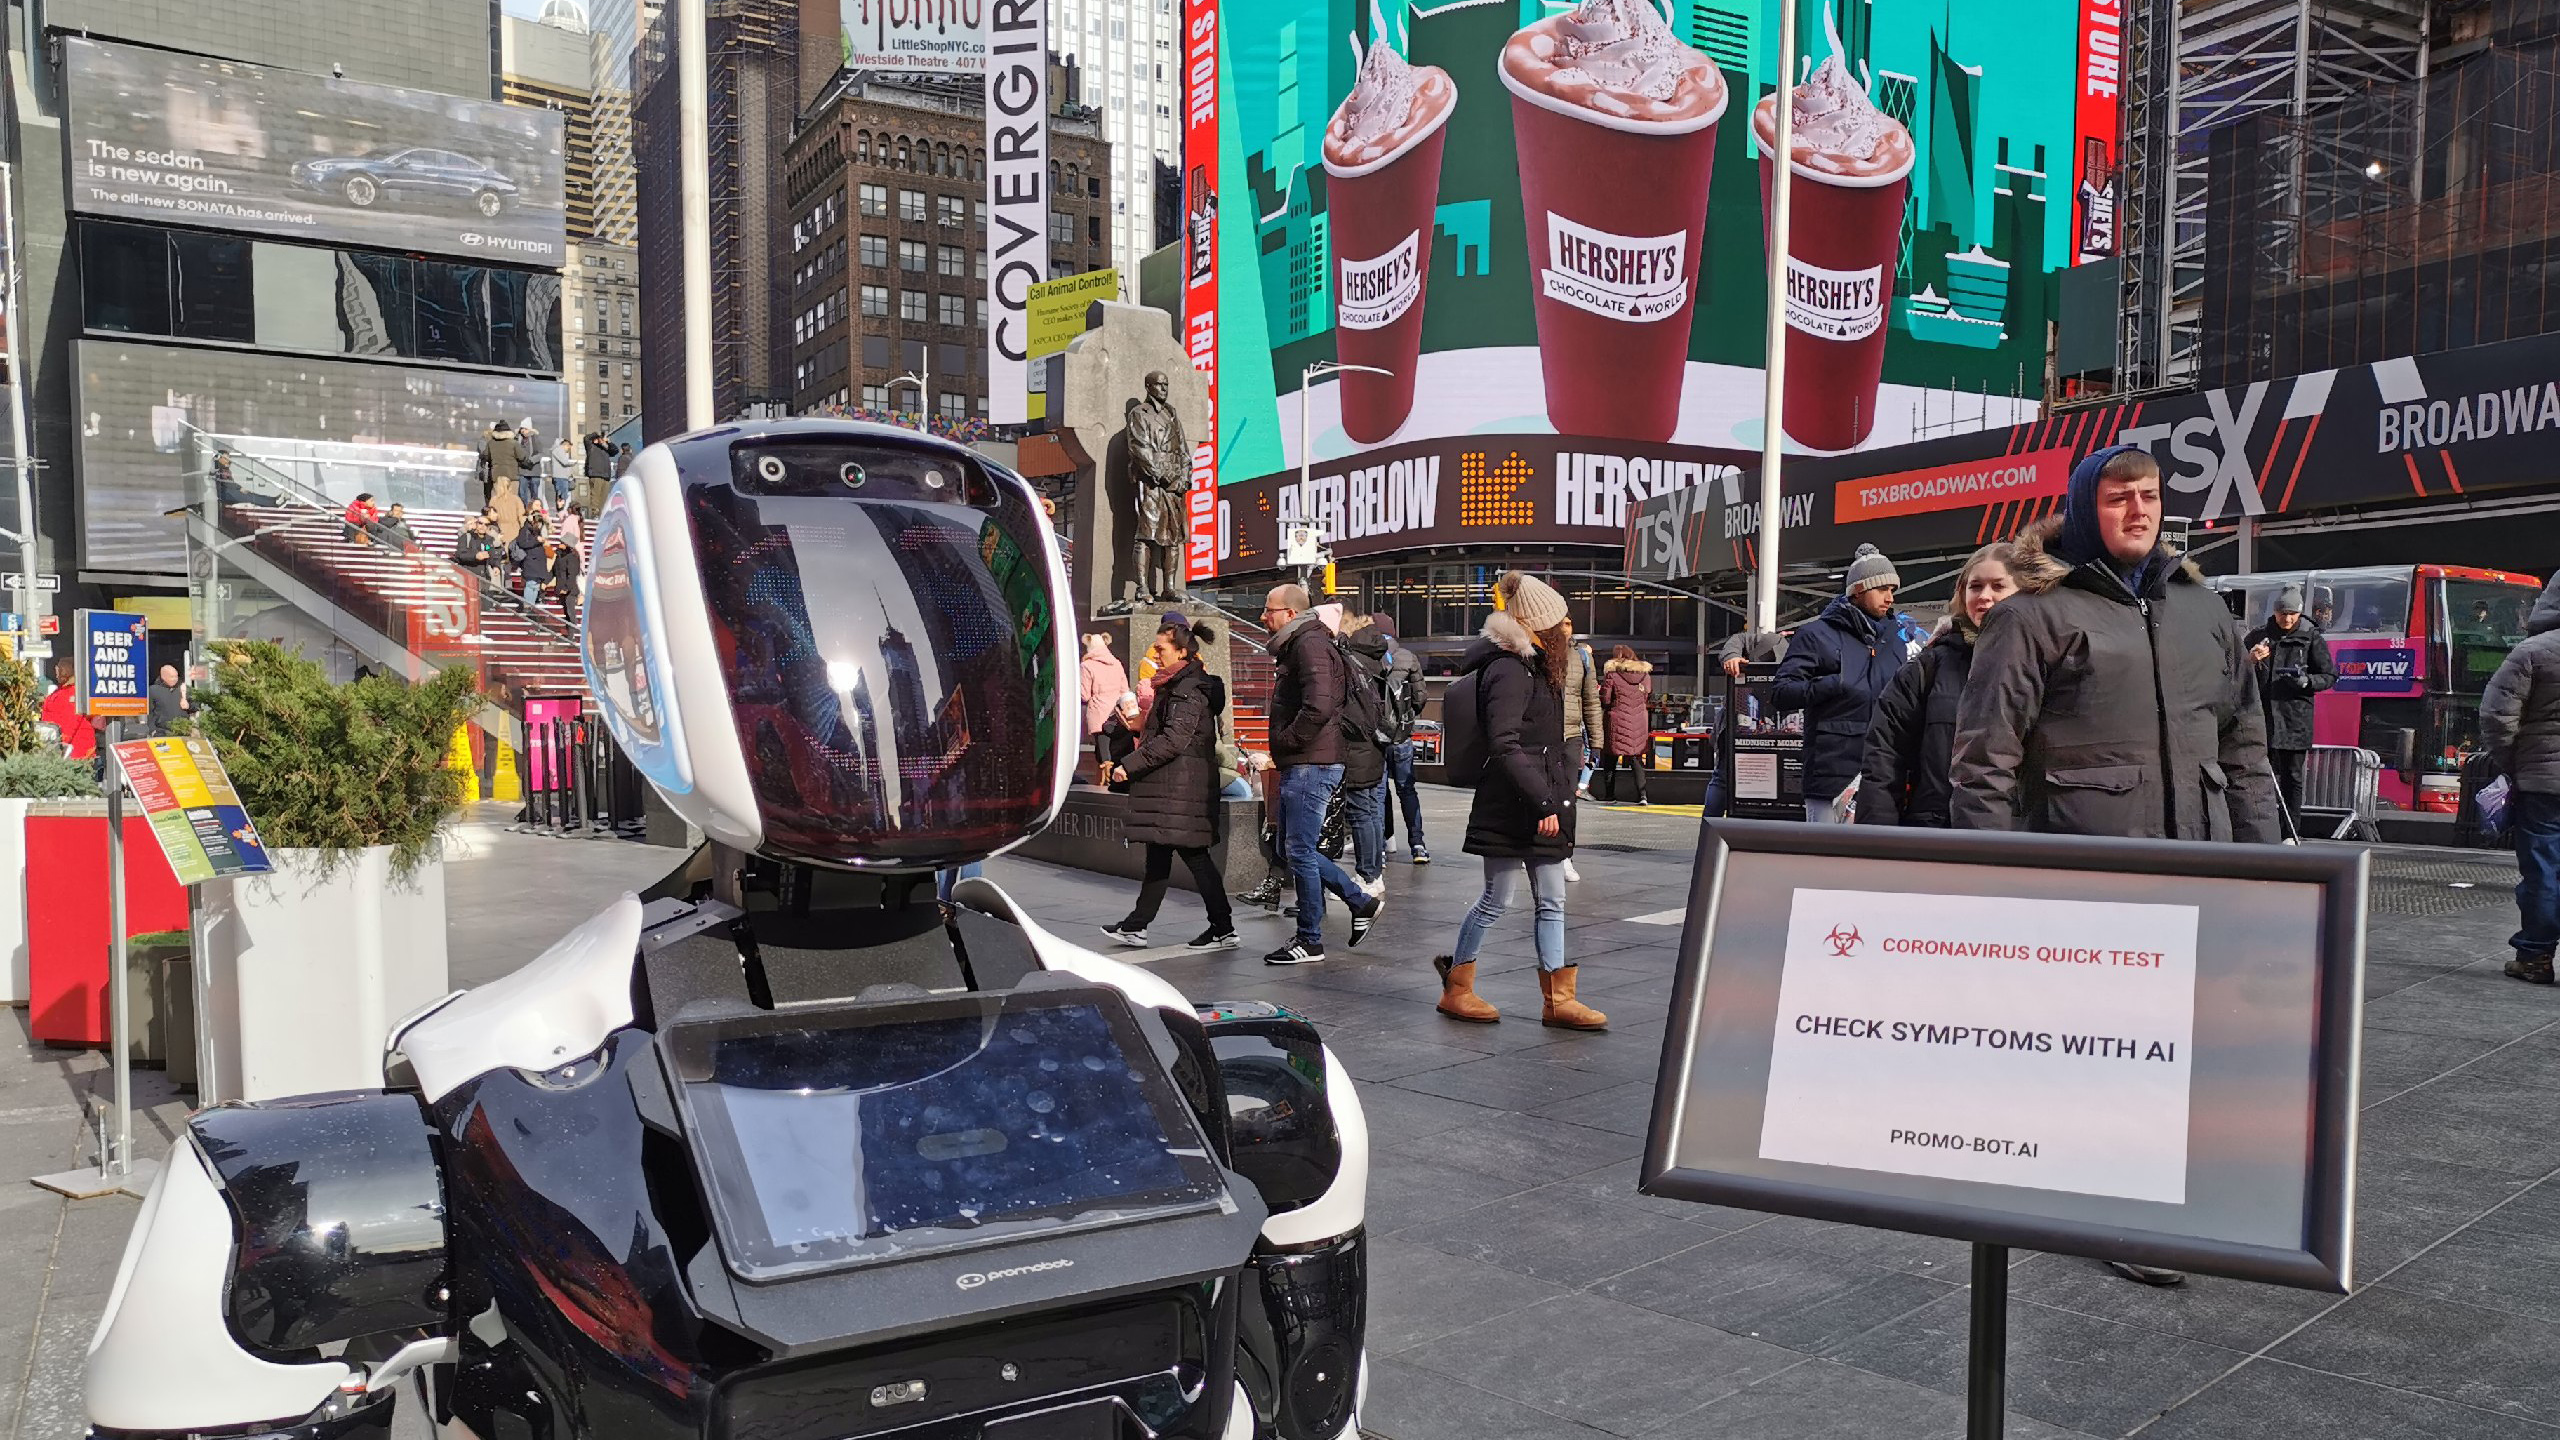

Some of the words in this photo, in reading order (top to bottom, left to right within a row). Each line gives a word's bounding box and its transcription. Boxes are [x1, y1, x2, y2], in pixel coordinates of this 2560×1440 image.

[854, 53, 904, 66] Westside
[907, 54, 948, 68] Theatre
[955, 56, 976, 68] 407
[1191, 9, 1216, 130] STORE
[86, 139, 130, 161] The
[135, 149, 205, 171] sedan
[88, 159, 106, 178] is
[112, 165, 160, 185] new
[165, 171, 235, 194] again.
[993, 0, 1040, 362] COVERGIR
[91, 188, 119, 202] The
[120, 194, 175, 210] all-new
[178, 199, 236, 216] SONATA
[237, 206, 263, 219] has
[265, 210, 316, 225] arrived.
[488, 236, 552, 254] HYUNDAI
[1559, 230, 1676, 285] HERSHEY'S
[1030, 284, 1046, 300] Call
[1047, 280, 1076, 297] Animal
[1346, 246, 1412, 302] HERSHEY'S
[1786, 266, 1875, 310] HERSHEY'S
[1342, 311, 1381, 324] CHOCOLATE
[1391, 284, 1416, 315] WORLD
[1550, 279, 1626, 314] CHOCOLATE
[1644, 292, 1682, 315] WORLD
[1786, 308, 1834, 334] HOCOLATE
[1848, 315, 1878, 334] WORLD
[1190, 310, 1214, 387] FRE
[2378, 381, 2560, 454] BROADWA
[1190, 400, 1214, 579] OCOLAT
[1350, 455, 1441, 539] BELOW
[1556, 452, 1742, 529] HERSH'
[1860, 464, 2036, 507] TSXBROADWAY.COM
[1278, 474, 1347, 551] ENTER
[1724, 492, 1814, 539] BROAWAY
[1636, 487, 1690, 581] TSX
[93, 630, 134, 646] BEER
[94, 648, 129, 662] AND
[94, 664, 135, 679] WINE
[2338, 662, 2408, 675] TOPVIEW
[94, 680, 137, 694] AREA
[1734, 738, 1776, 748] MIDNIGHT
[1050, 812, 1080, 838] HER
[1883, 938, 2030, 960] CORONAVIRUS
[2036, 946, 2103, 965] QUICK
[2108, 950, 2165, 968] TEST
[1795, 1014, 1885, 1040] CHECK
[1890, 1022, 2053, 1054] SYMPTOMS
[2060, 1034, 2137, 1059] WITH
[2145, 1041, 2175, 1062] AI
[1890, 1129, 2038, 1158] PROMO-BOT.AI
[987, 1258, 1074, 1281] promobot
